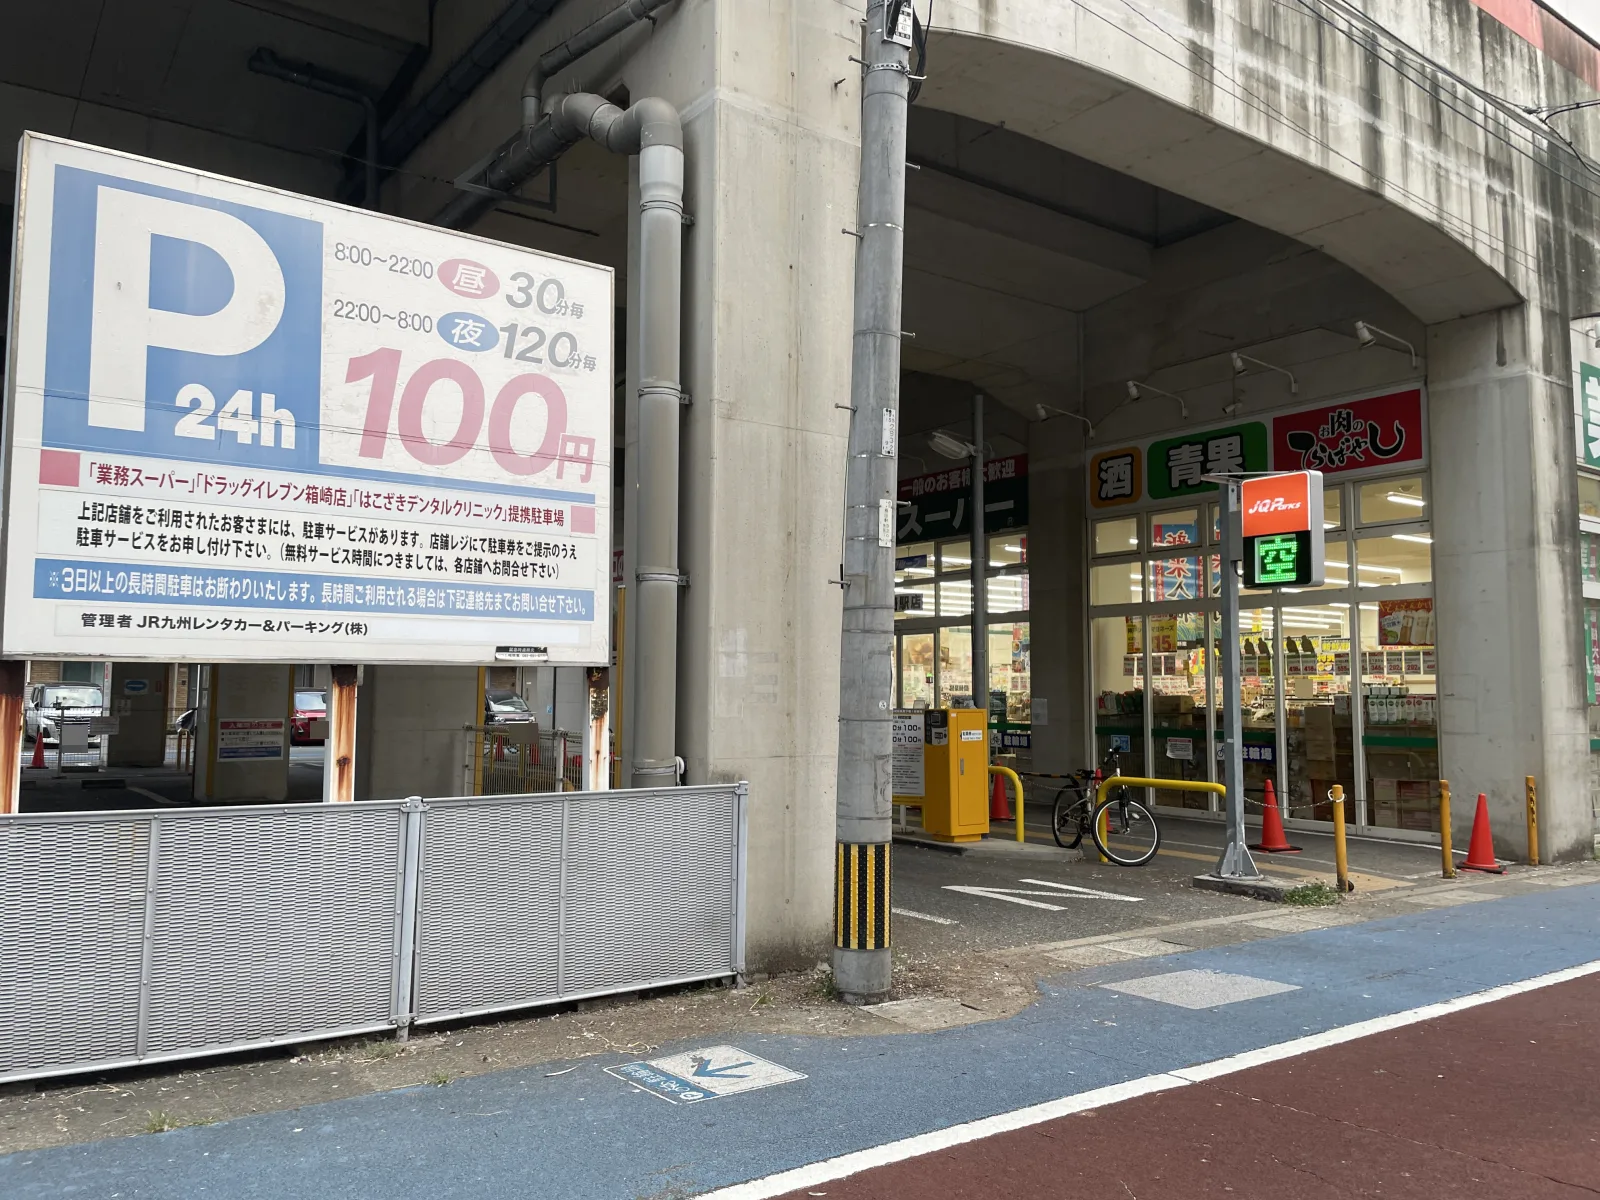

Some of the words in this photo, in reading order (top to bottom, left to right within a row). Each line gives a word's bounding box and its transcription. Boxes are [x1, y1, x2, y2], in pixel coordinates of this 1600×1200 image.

[88, 185, 286, 432] P
[334, 242, 434, 279] 8:00〜22:00
[451, 264, 486, 295] 昼
[505, 271, 585, 320] 30分毎
[333, 299, 433, 333] 22:00〜8:00
[451, 319, 485, 347] 夜
[499, 322, 597, 372] 120分毎
[174, 383, 296, 449] 24h
[344, 347, 596, 484] 100円
[1319, 409, 1365, 439] お肉の
[1099, 454, 1134, 499] 酒
[1167, 434, 1244, 489] 青果
[1259, 537, 1298, 582] 空
[81, 613, 133, 629] 管理者
[895, 594, 922, 611] 駅店
